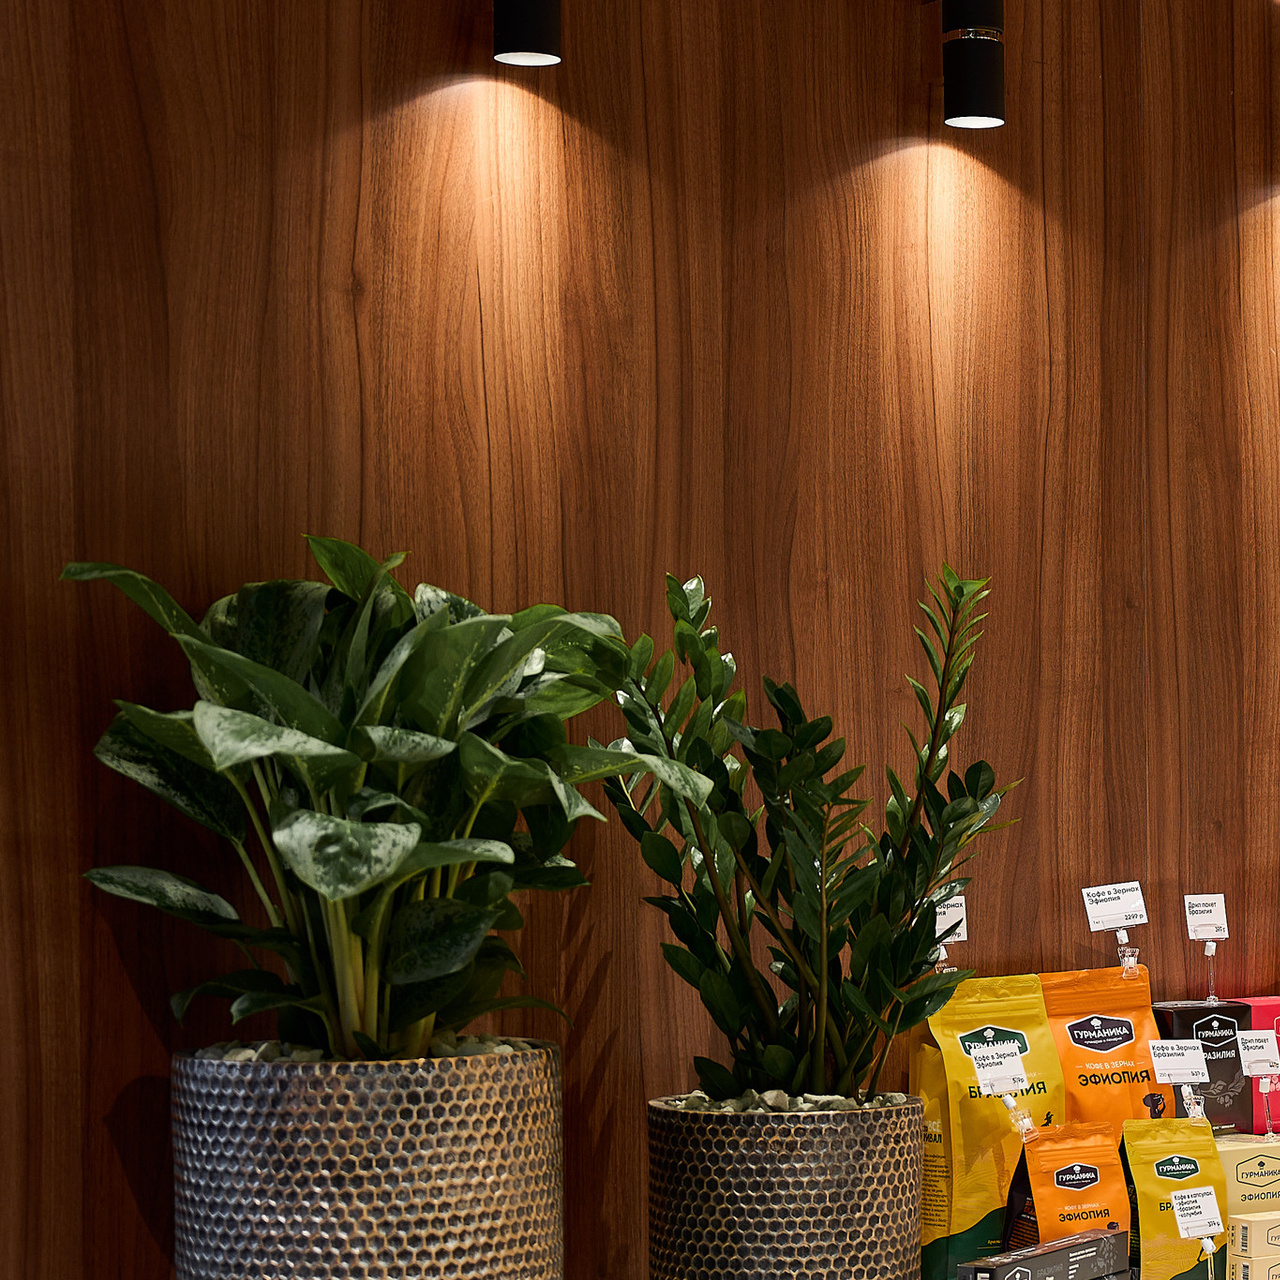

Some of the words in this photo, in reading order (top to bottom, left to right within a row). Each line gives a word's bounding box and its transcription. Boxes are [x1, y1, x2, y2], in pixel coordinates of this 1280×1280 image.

[1074, 1026, 1130, 1039] ГУРМАНИКА
[1198, 1029, 1234, 1038] ГУРМАНИКА
[1203, 1049, 1236, 1061] РАЗИЛИЯ
[1078, 1069, 1151, 1087] ЭФИОПИЯ
[1058, 1209, 1110, 1222] ЭФИОПИЯ
